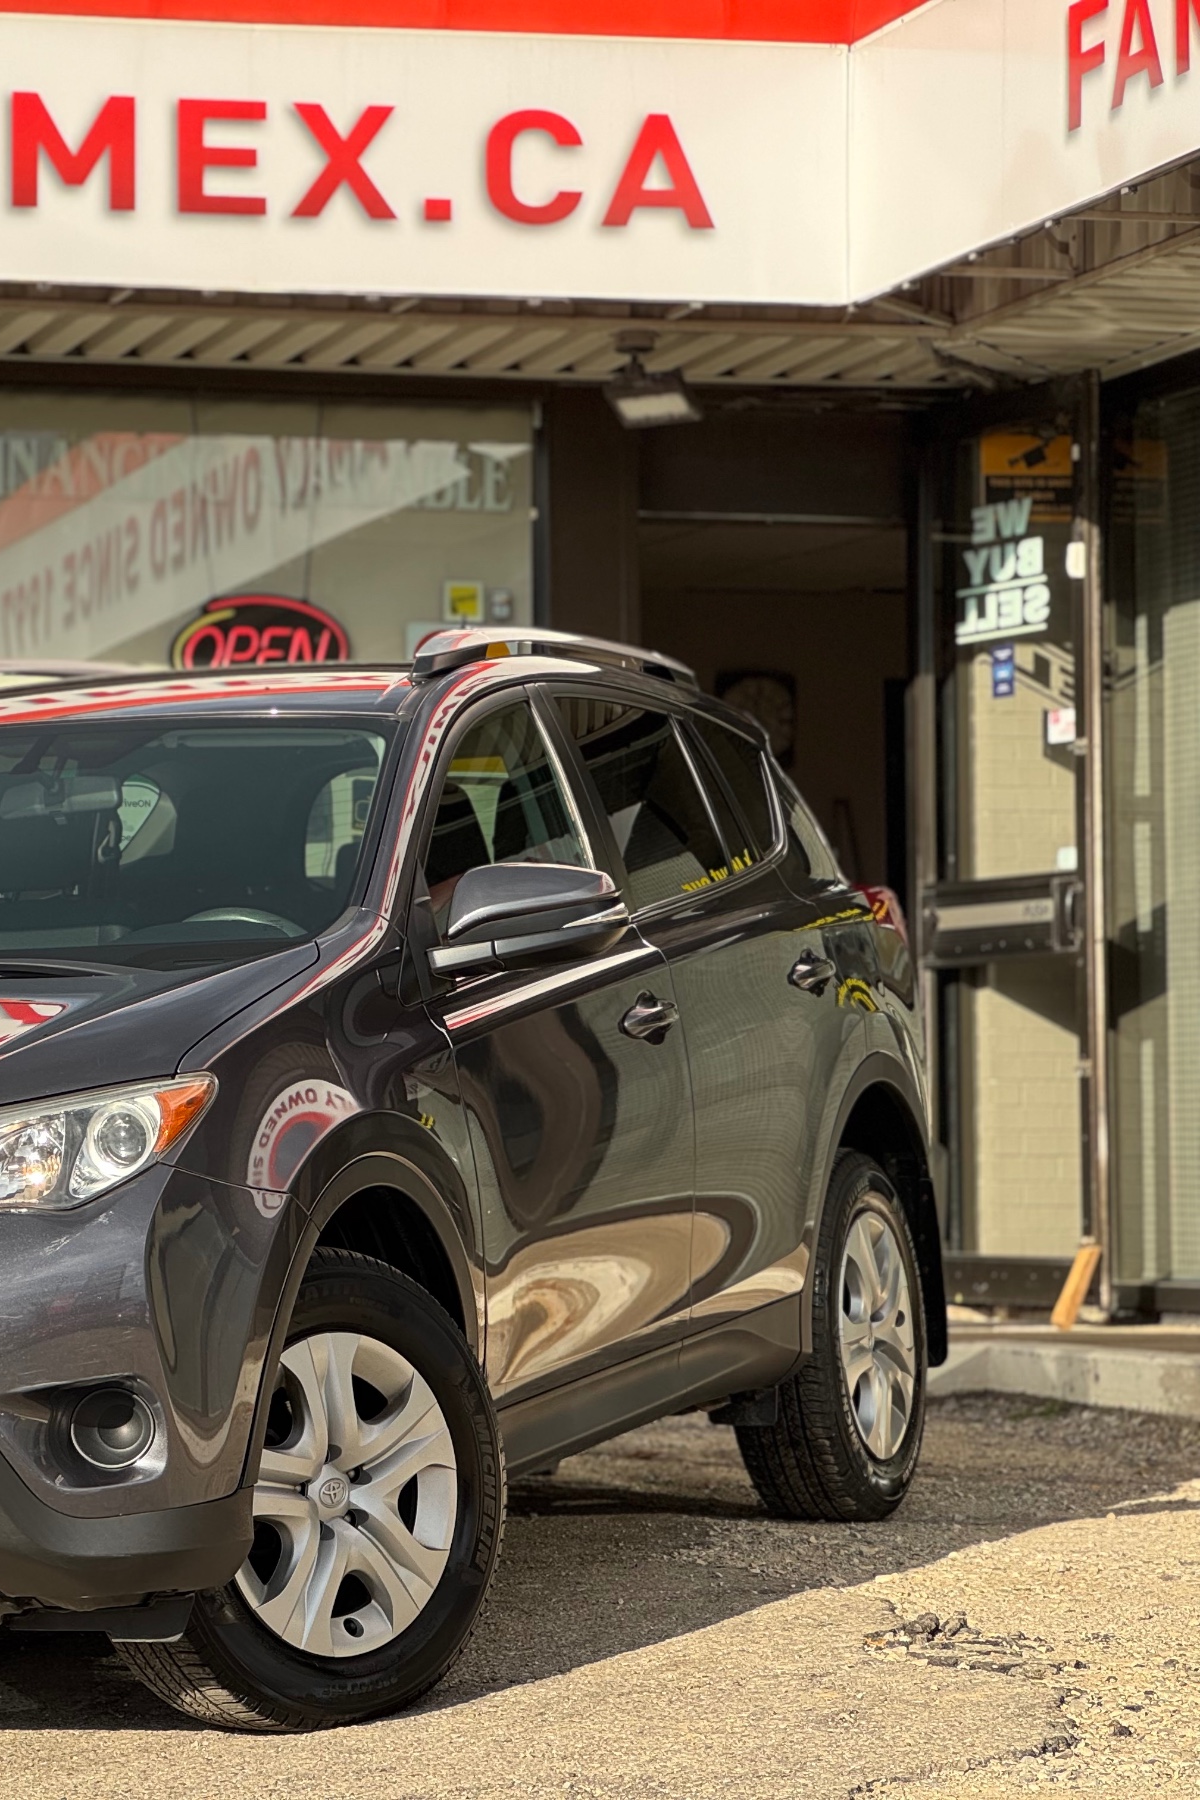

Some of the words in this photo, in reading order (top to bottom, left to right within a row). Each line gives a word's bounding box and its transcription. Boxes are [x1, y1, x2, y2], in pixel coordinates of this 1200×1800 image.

[184, 625, 331, 668] OPEN
[122, 799, 151, 808] iveON
[473, 1414, 497, 1571] MICHELIN
